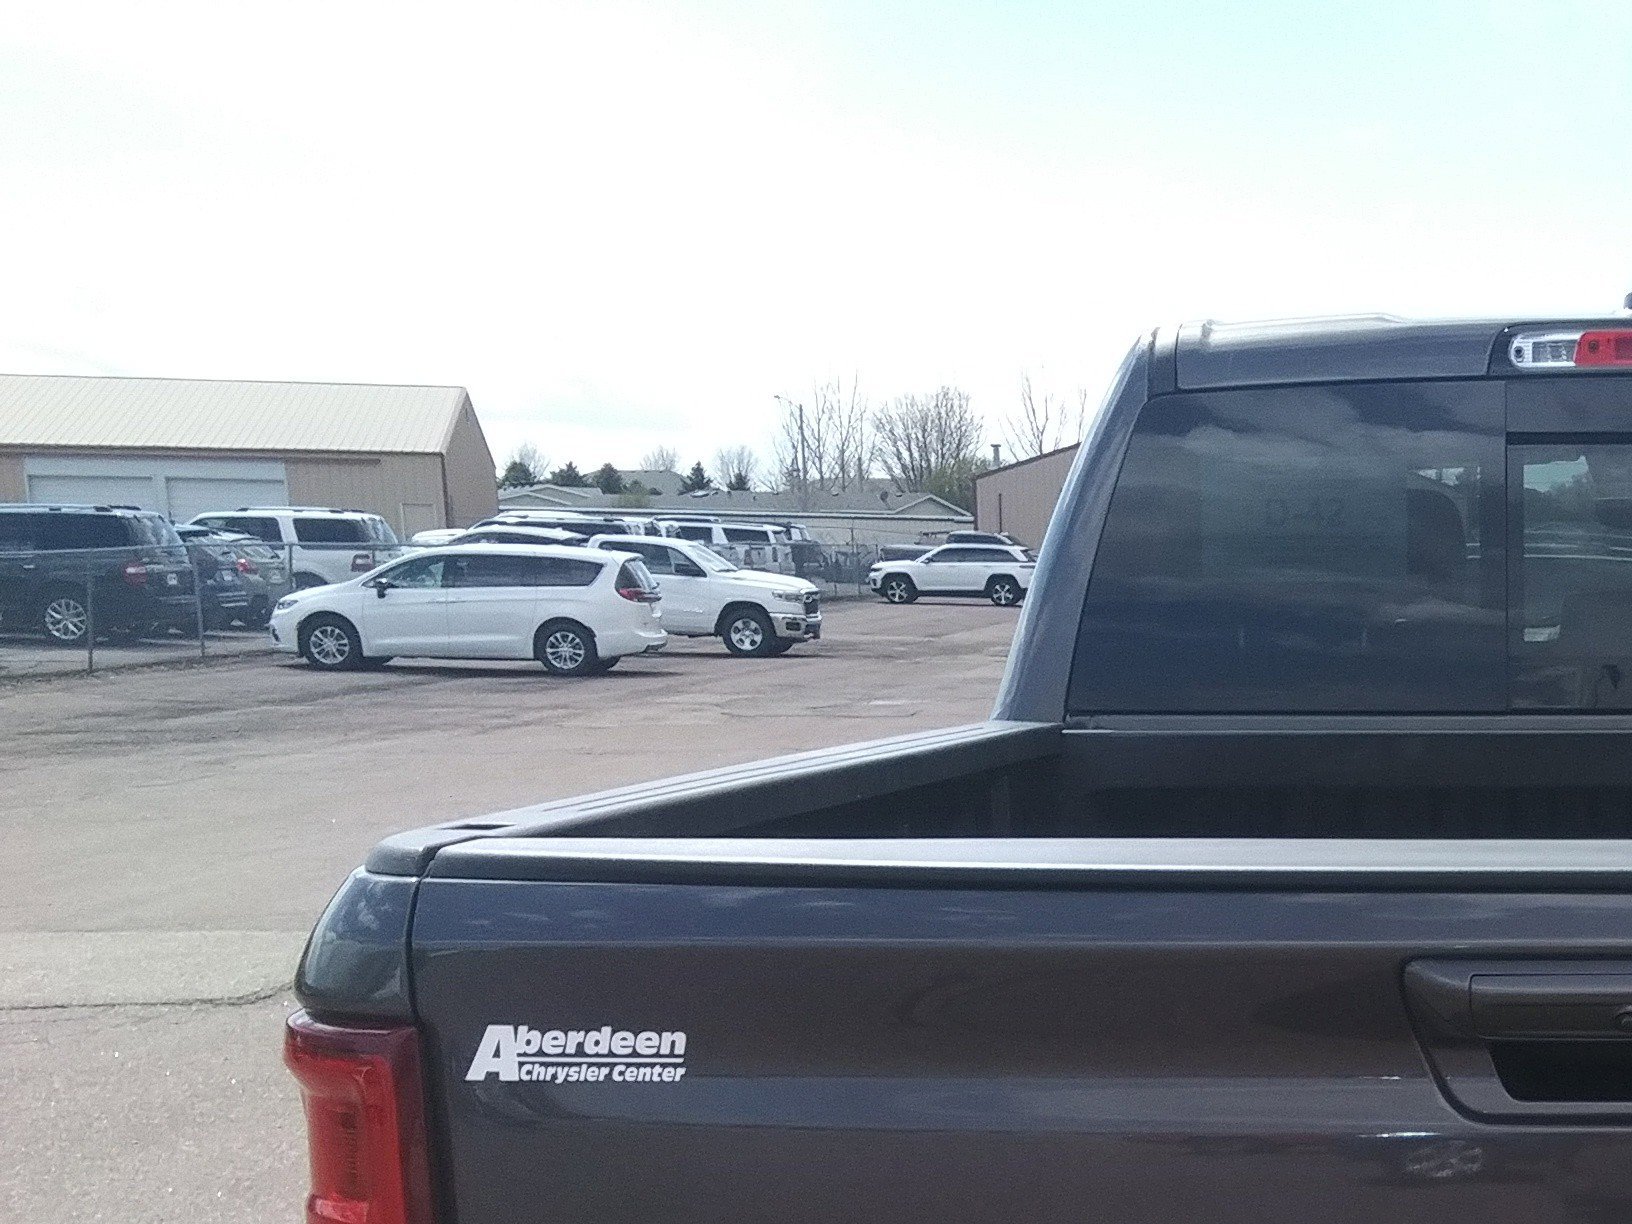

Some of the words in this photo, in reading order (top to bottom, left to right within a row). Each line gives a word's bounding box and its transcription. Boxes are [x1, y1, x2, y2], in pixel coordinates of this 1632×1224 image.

[465, 1024, 687, 1081] Aberdeen
[520, 1063, 611, 1084] Chrysler
[612, 1064, 687, 1082] Center
